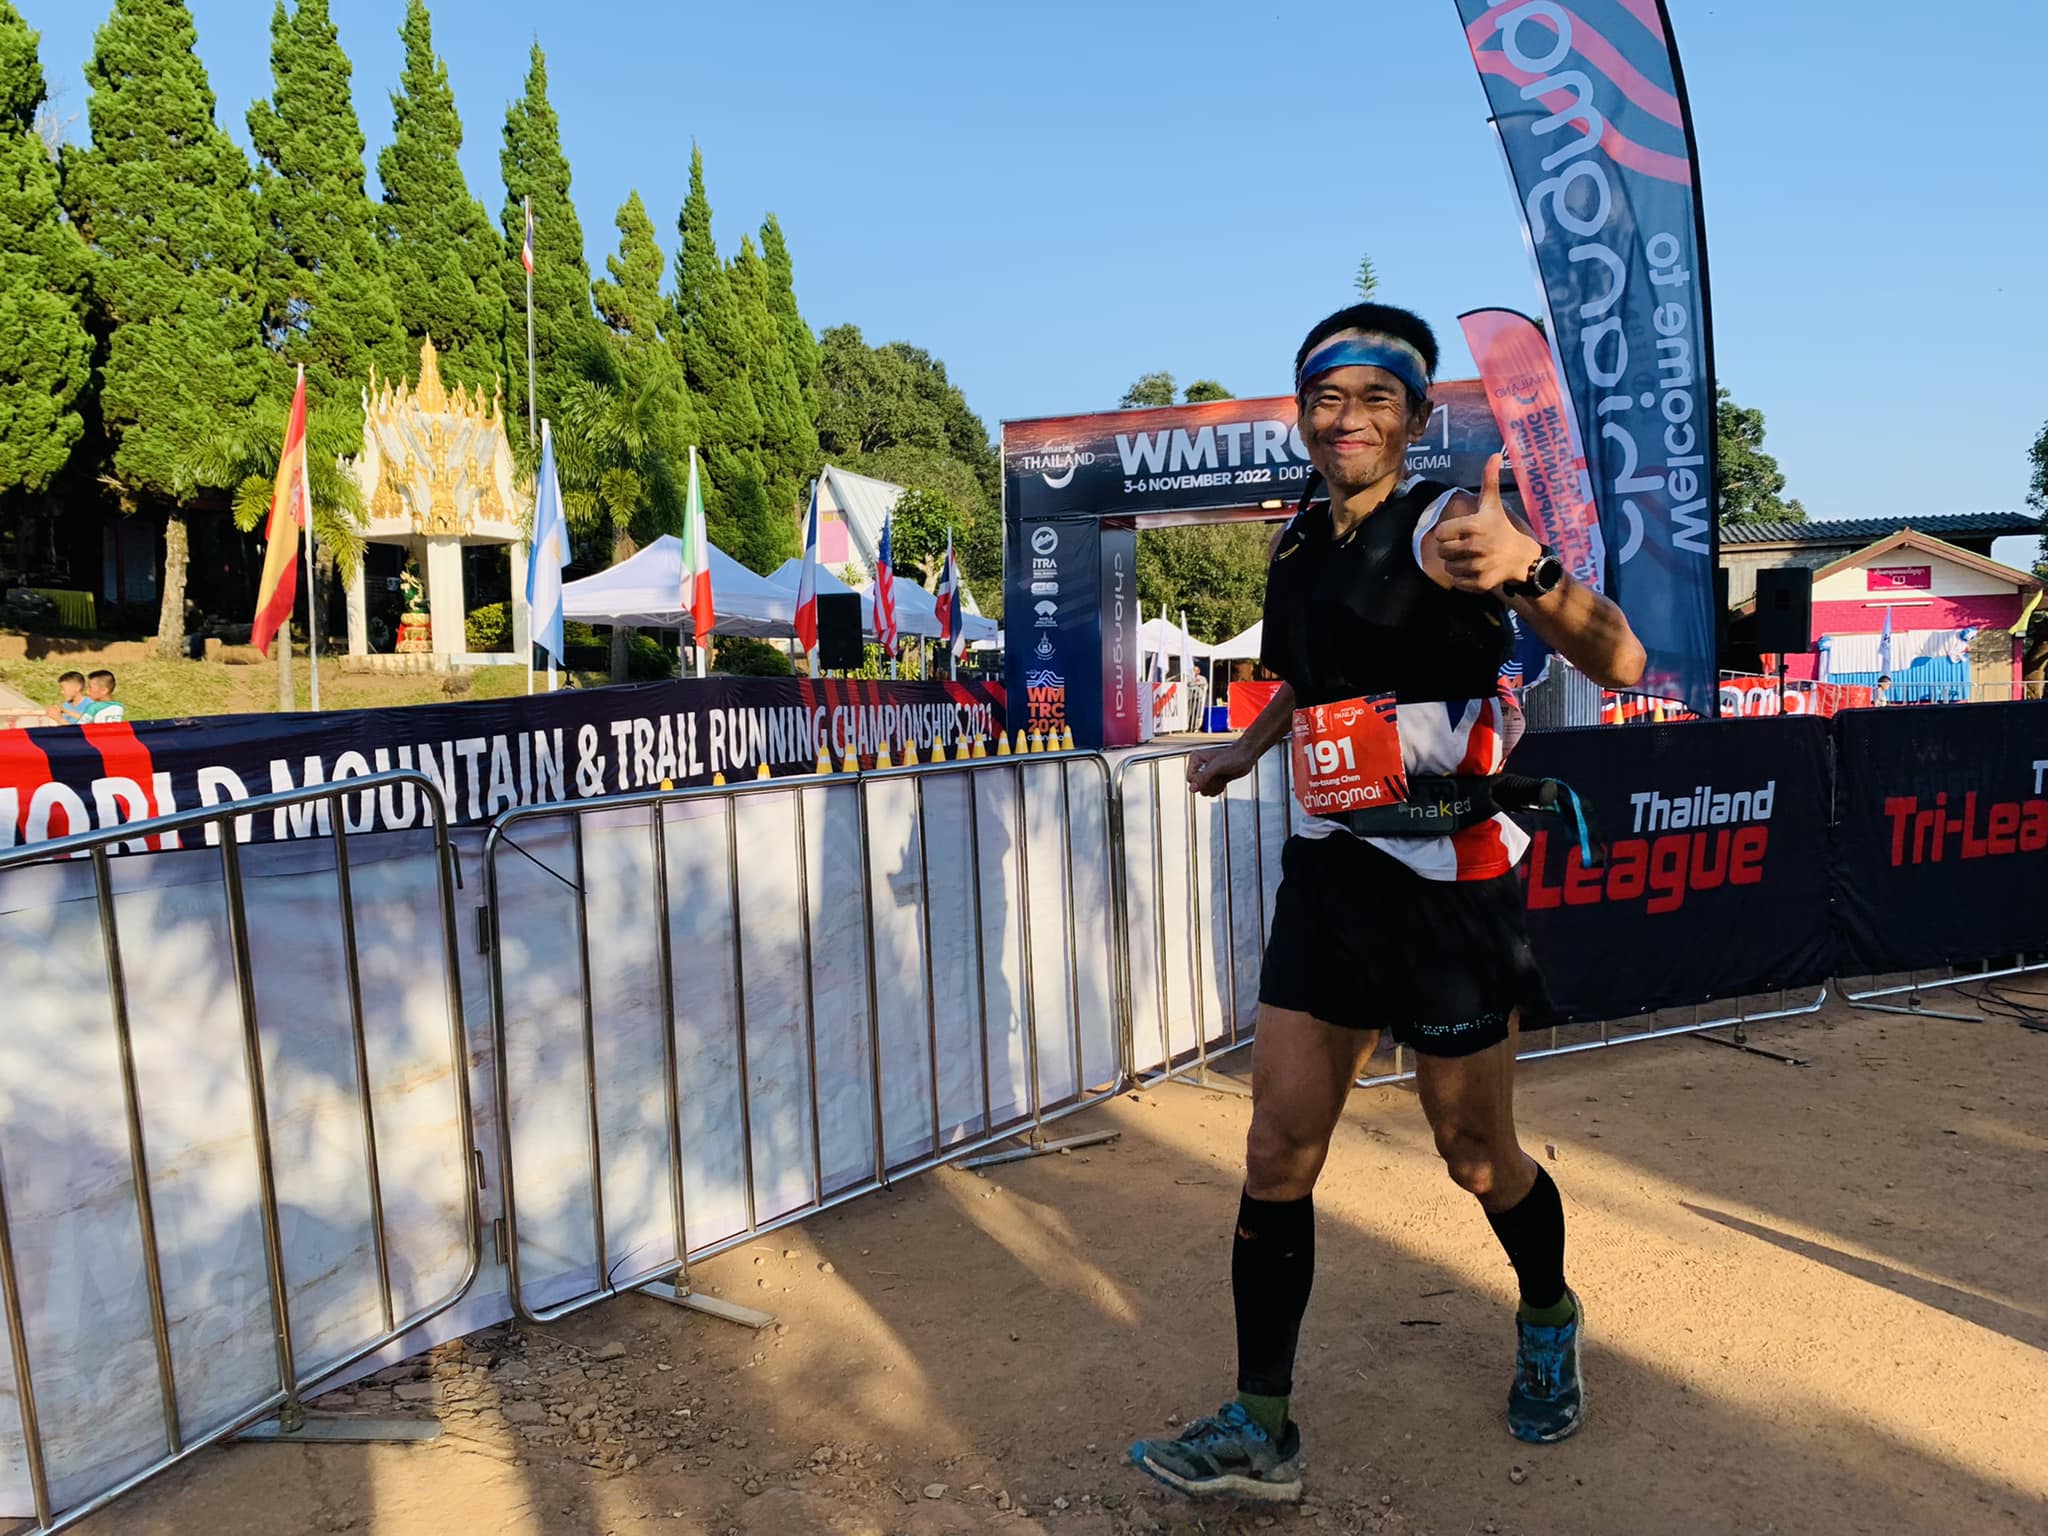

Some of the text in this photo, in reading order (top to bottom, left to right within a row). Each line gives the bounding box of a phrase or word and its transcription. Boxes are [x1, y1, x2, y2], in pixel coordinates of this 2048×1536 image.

[1022, 452, 1096, 470] THAILAND
[1123, 478, 1147, 493] 3-6
[1149, 472, 1232, 491] NOVEMBER
[1234, 469, 1271, 484] 2022
[1279, 466, 1303, 480] DOI
[1404, 454, 1451, 471] NGMAI
[1112, 552, 1125, 718] chiangmai
[1027, 687, 1065, 702] WM
[1027, 702, 1065, 718] TRC
[1028, 718, 1065, 733] 2021
[269, 728, 566, 840] MOUNTAIN
[575, 723, 606, 798] &
[611, 712, 704, 790] TRAIL
[709, 705, 827, 772] RUNNING
[832, 703, 963, 758] CHAMPIONSHIPS
[963, 702, 993, 743] 2021
[1303, 736, 1356, 776] 191
[1303, 781, 1381, 808] chiangmai
[1410, 796, 1471, 819] naked
[1630, 780, 1776, 832] Thailand
[1520, 825, 1769, 914] -League
